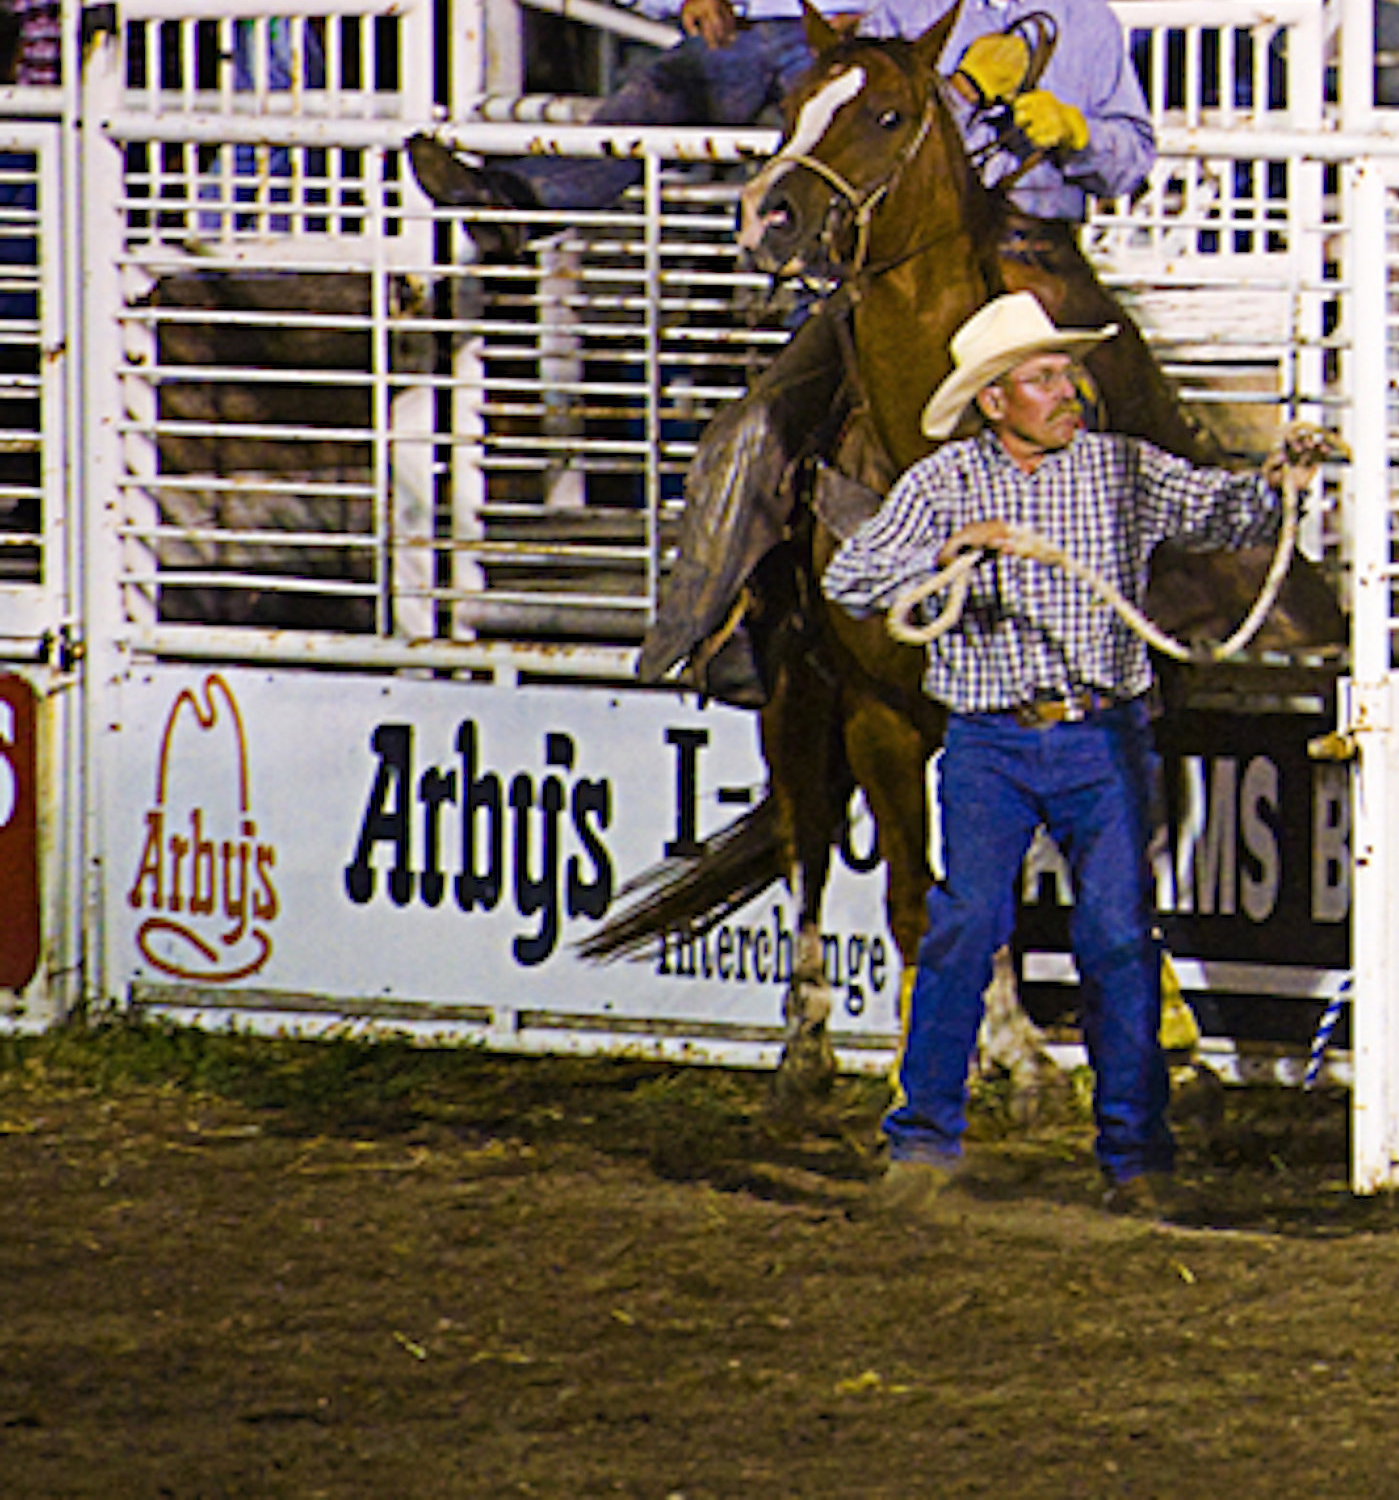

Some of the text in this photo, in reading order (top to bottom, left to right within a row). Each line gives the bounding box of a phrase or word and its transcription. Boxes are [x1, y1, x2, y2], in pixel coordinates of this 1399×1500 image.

[127, 811, 279, 944] Arby's
[345, 719, 614, 966] Arby's
[655, 903, 886, 1017] Interchnge
